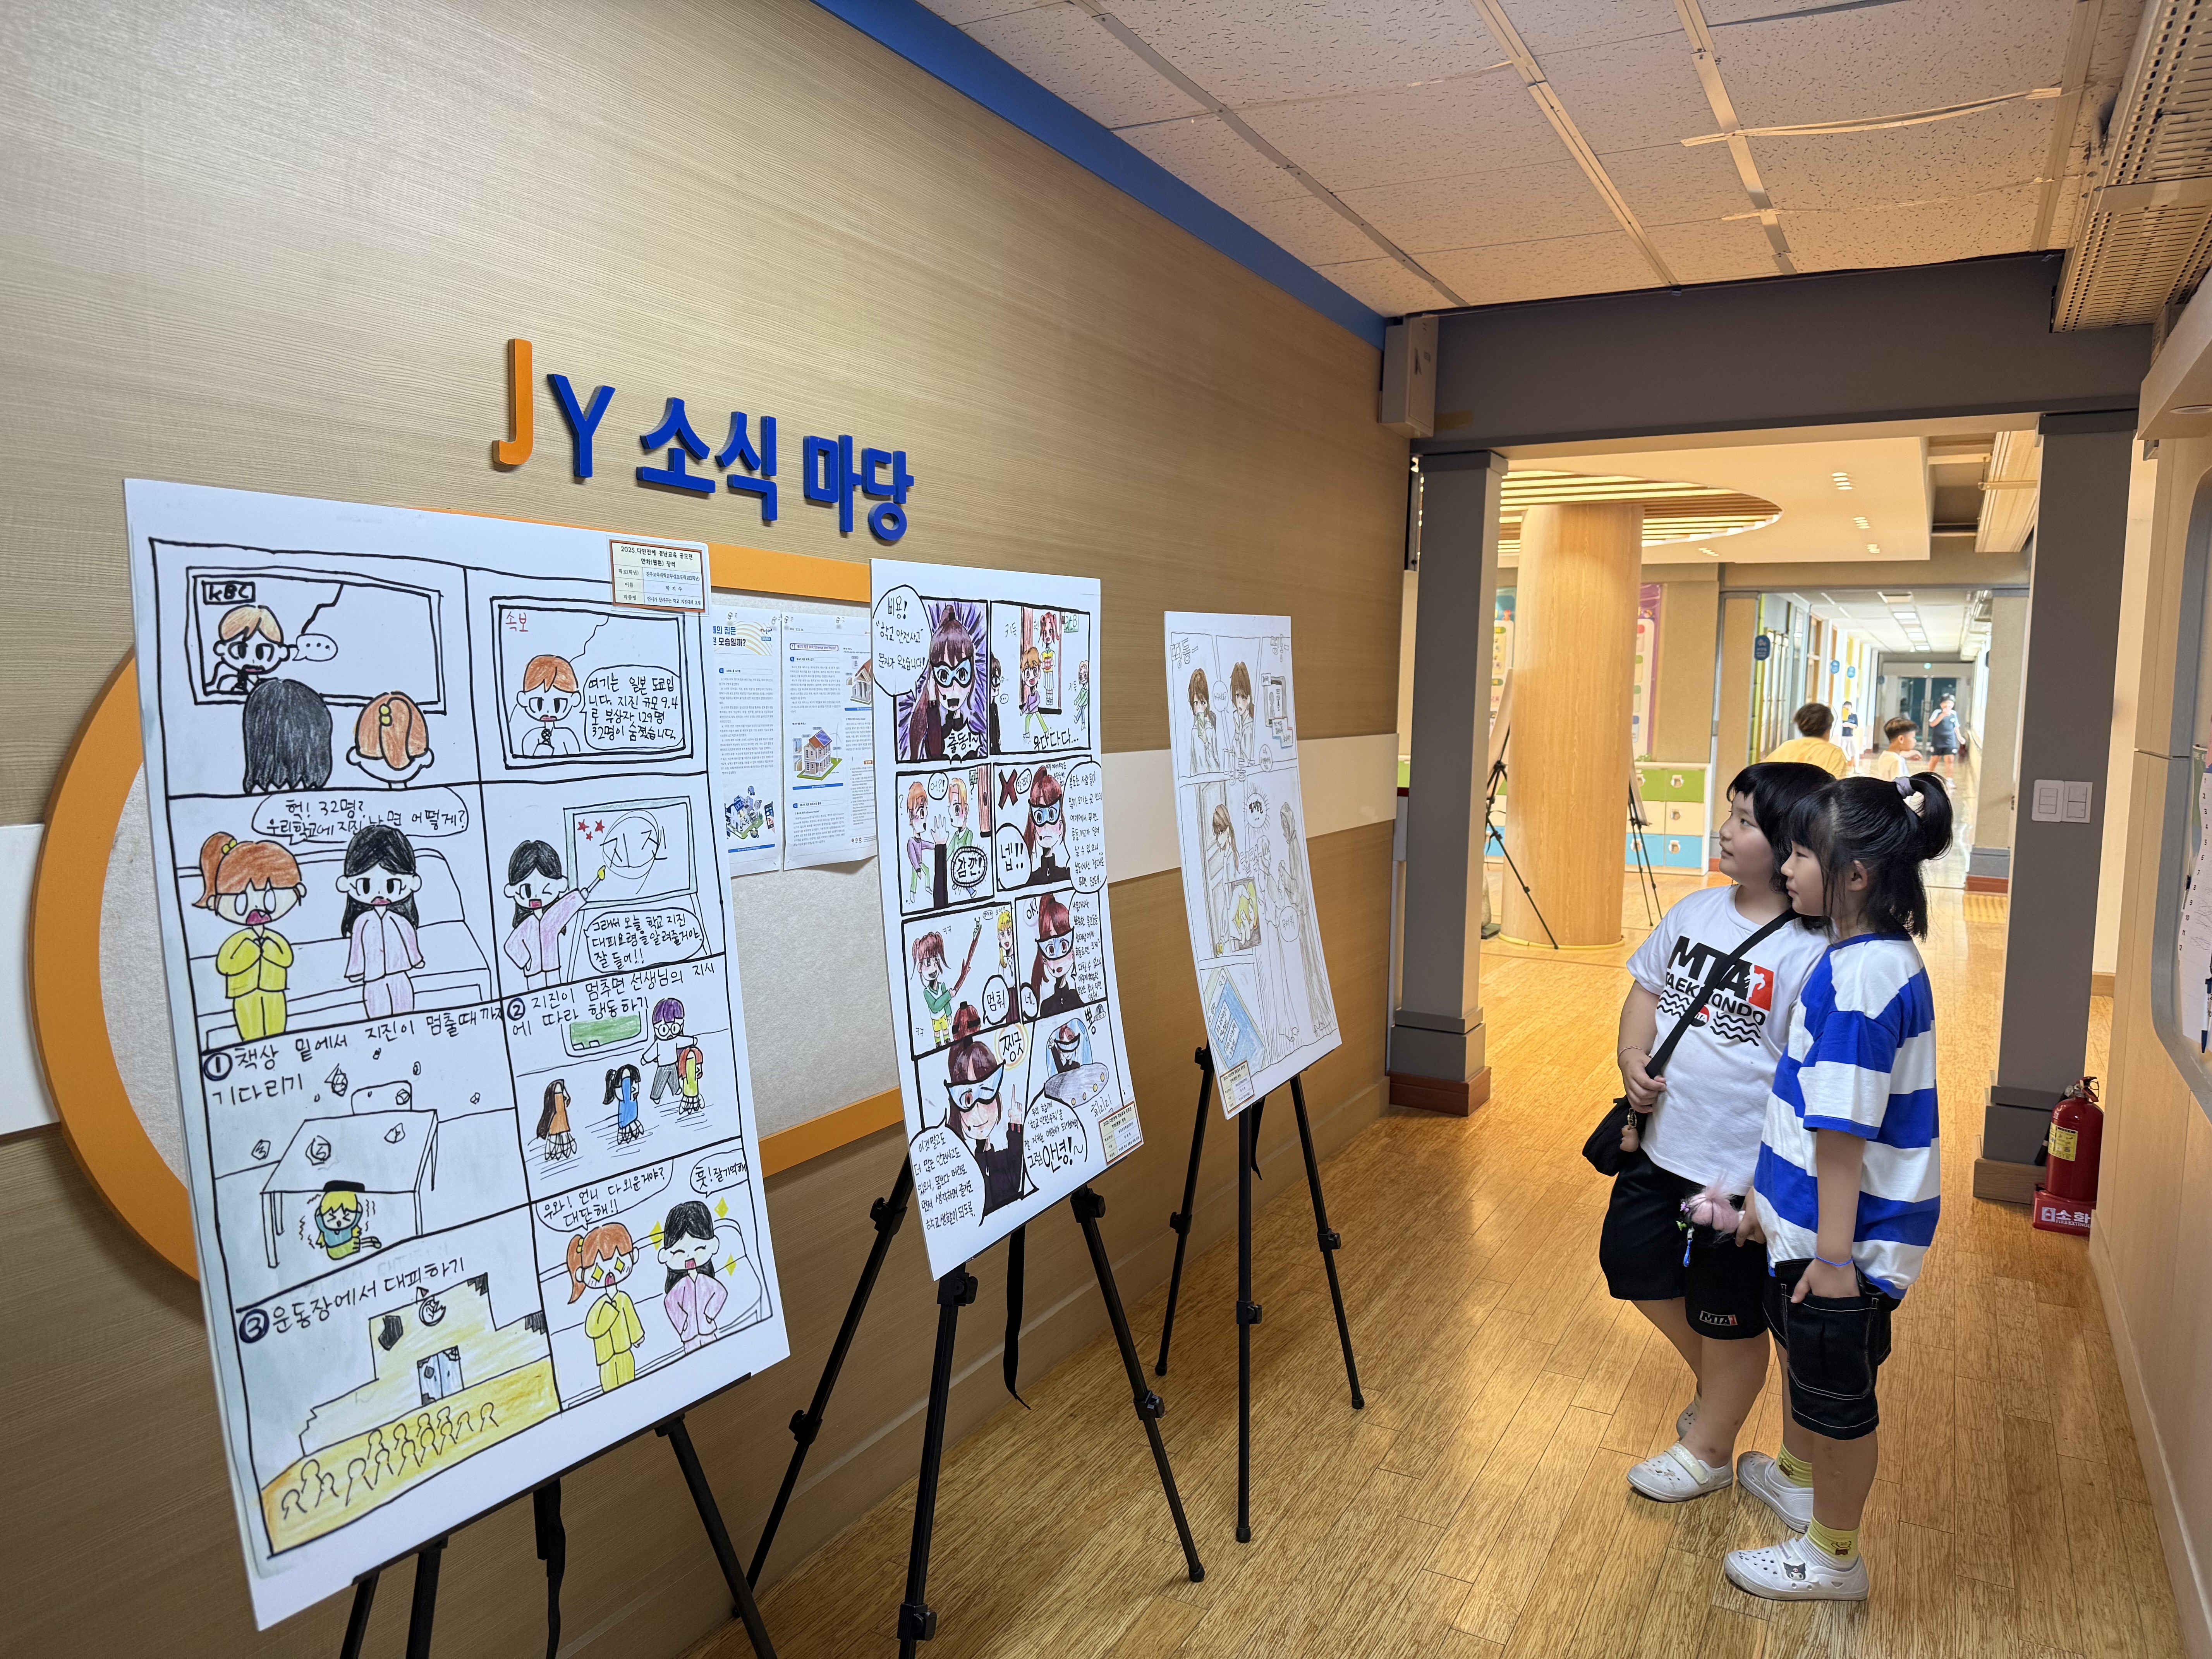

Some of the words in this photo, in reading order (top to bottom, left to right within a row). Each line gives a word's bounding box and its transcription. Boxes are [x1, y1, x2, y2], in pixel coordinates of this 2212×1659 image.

[636, 397, 778, 521] 소식
[803, 434, 915, 541] 마당
[505, 611, 529, 632] 속보
[724, 626, 737, 635] 집은
[718, 637, 746, 647] 모습일까?
[879, 653, 895, 669] 문자가
[588, 673, 620, 692] 여기는
[629, 676, 647, 695] 일본
[652, 676, 675, 691] 도쿄입
[618, 696, 638, 709] 지진
[642, 697, 658, 710] 규모
[591, 709, 599, 725] 로
[606, 709, 635, 725] 부상자
[638, 711, 665, 725] 129명
[592, 726, 624, 740] 32명이
[1069, 774, 1080, 790] 복도는
[286, 799, 310, 821] 헉!
[319, 799, 366, 819] 32명?
[337, 820, 364, 835] 지진
[599, 826, 668, 869] 지진
[956, 856, 982, 878] 잠깐!
[592, 918, 620, 931] 그래서
[624, 915, 642, 933] 오늘
[646, 916, 665, 928] 학교
[666, 914, 686, 927] 지진
[594, 951, 608, 967] 잘
[531, 988, 575, 1010] 지진이
[585, 977, 625, 1000] 멈추면
[630, 970, 683, 992] 선생님의
[694, 962, 715, 976] 지시
[986, 991, 1006, 1012] 멈춰
[512, 1020, 532, 1037] 에
[542, 1009, 579, 1026] 따라
[234, 1044, 279, 1071] 책상
[295, 1032, 349, 1061] 밑에서
[365, 1020, 415, 1041] 지진이
[212, 1073, 303, 1105] 기다리기
[1032, 1107, 1039, 1116] 우리
[1041, 1100, 1053, 1113] 함께
[1024, 1140, 1031, 1151] 잘
[914, 1163, 922, 1176] 더
[923, 1159, 936, 1173] 많은
[1027, 1151, 1043, 1169] 그럼
[544, 1196, 572, 1219] 우와!
[579, 1188, 598, 1205] 언니
[563, 1198, 619, 1226] 대단해!!
[921, 1199, 933, 1212] 먼저
[273, 1282, 377, 1333] 운동장에서
[384, 1257, 464, 1291] 대피하기
